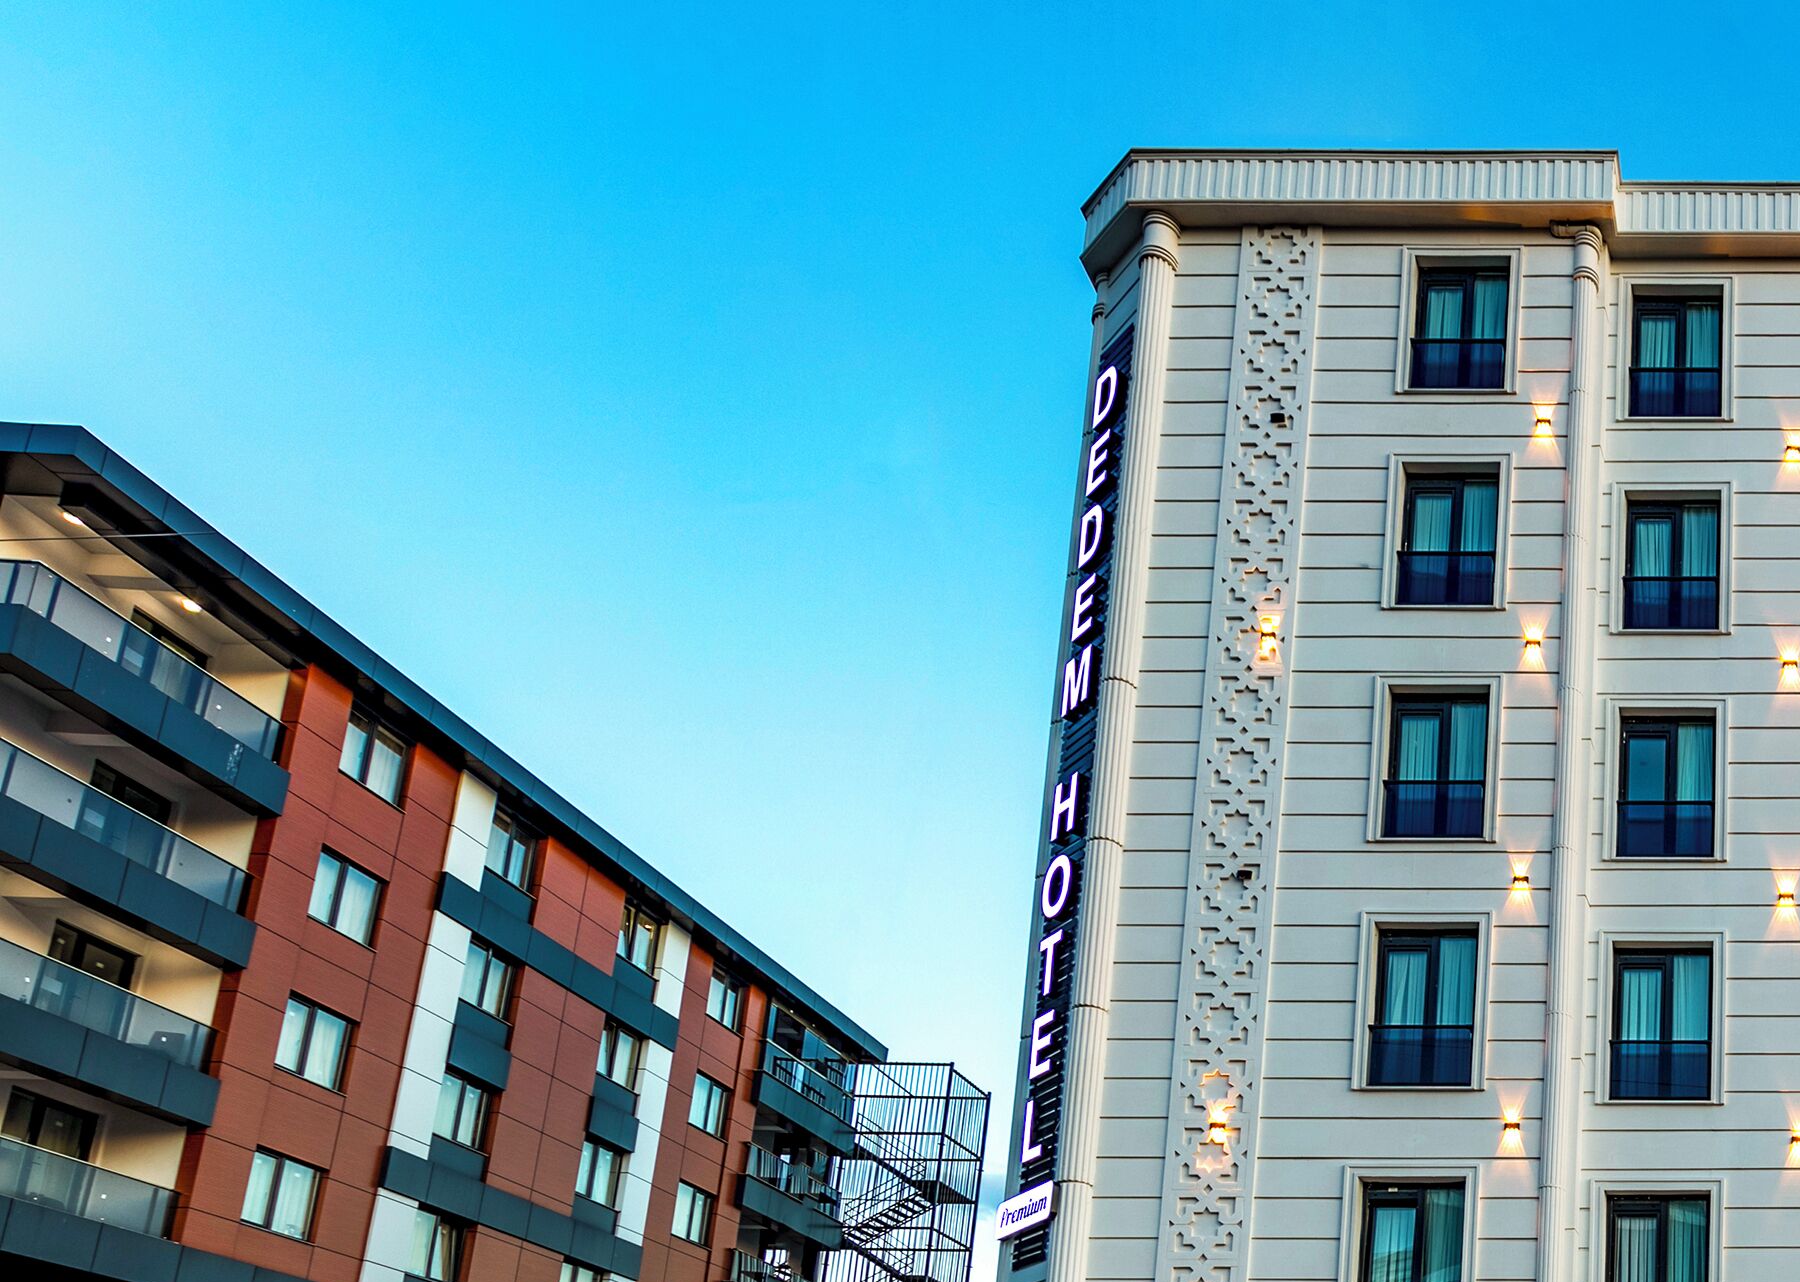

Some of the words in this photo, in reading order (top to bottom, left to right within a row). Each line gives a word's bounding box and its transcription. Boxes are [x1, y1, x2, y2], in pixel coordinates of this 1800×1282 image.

[1060, 364, 1119, 719] DEDEM
[1020, 770, 1079, 1164] HOTEL
[1000, 1196, 1048, 1228] Premium
